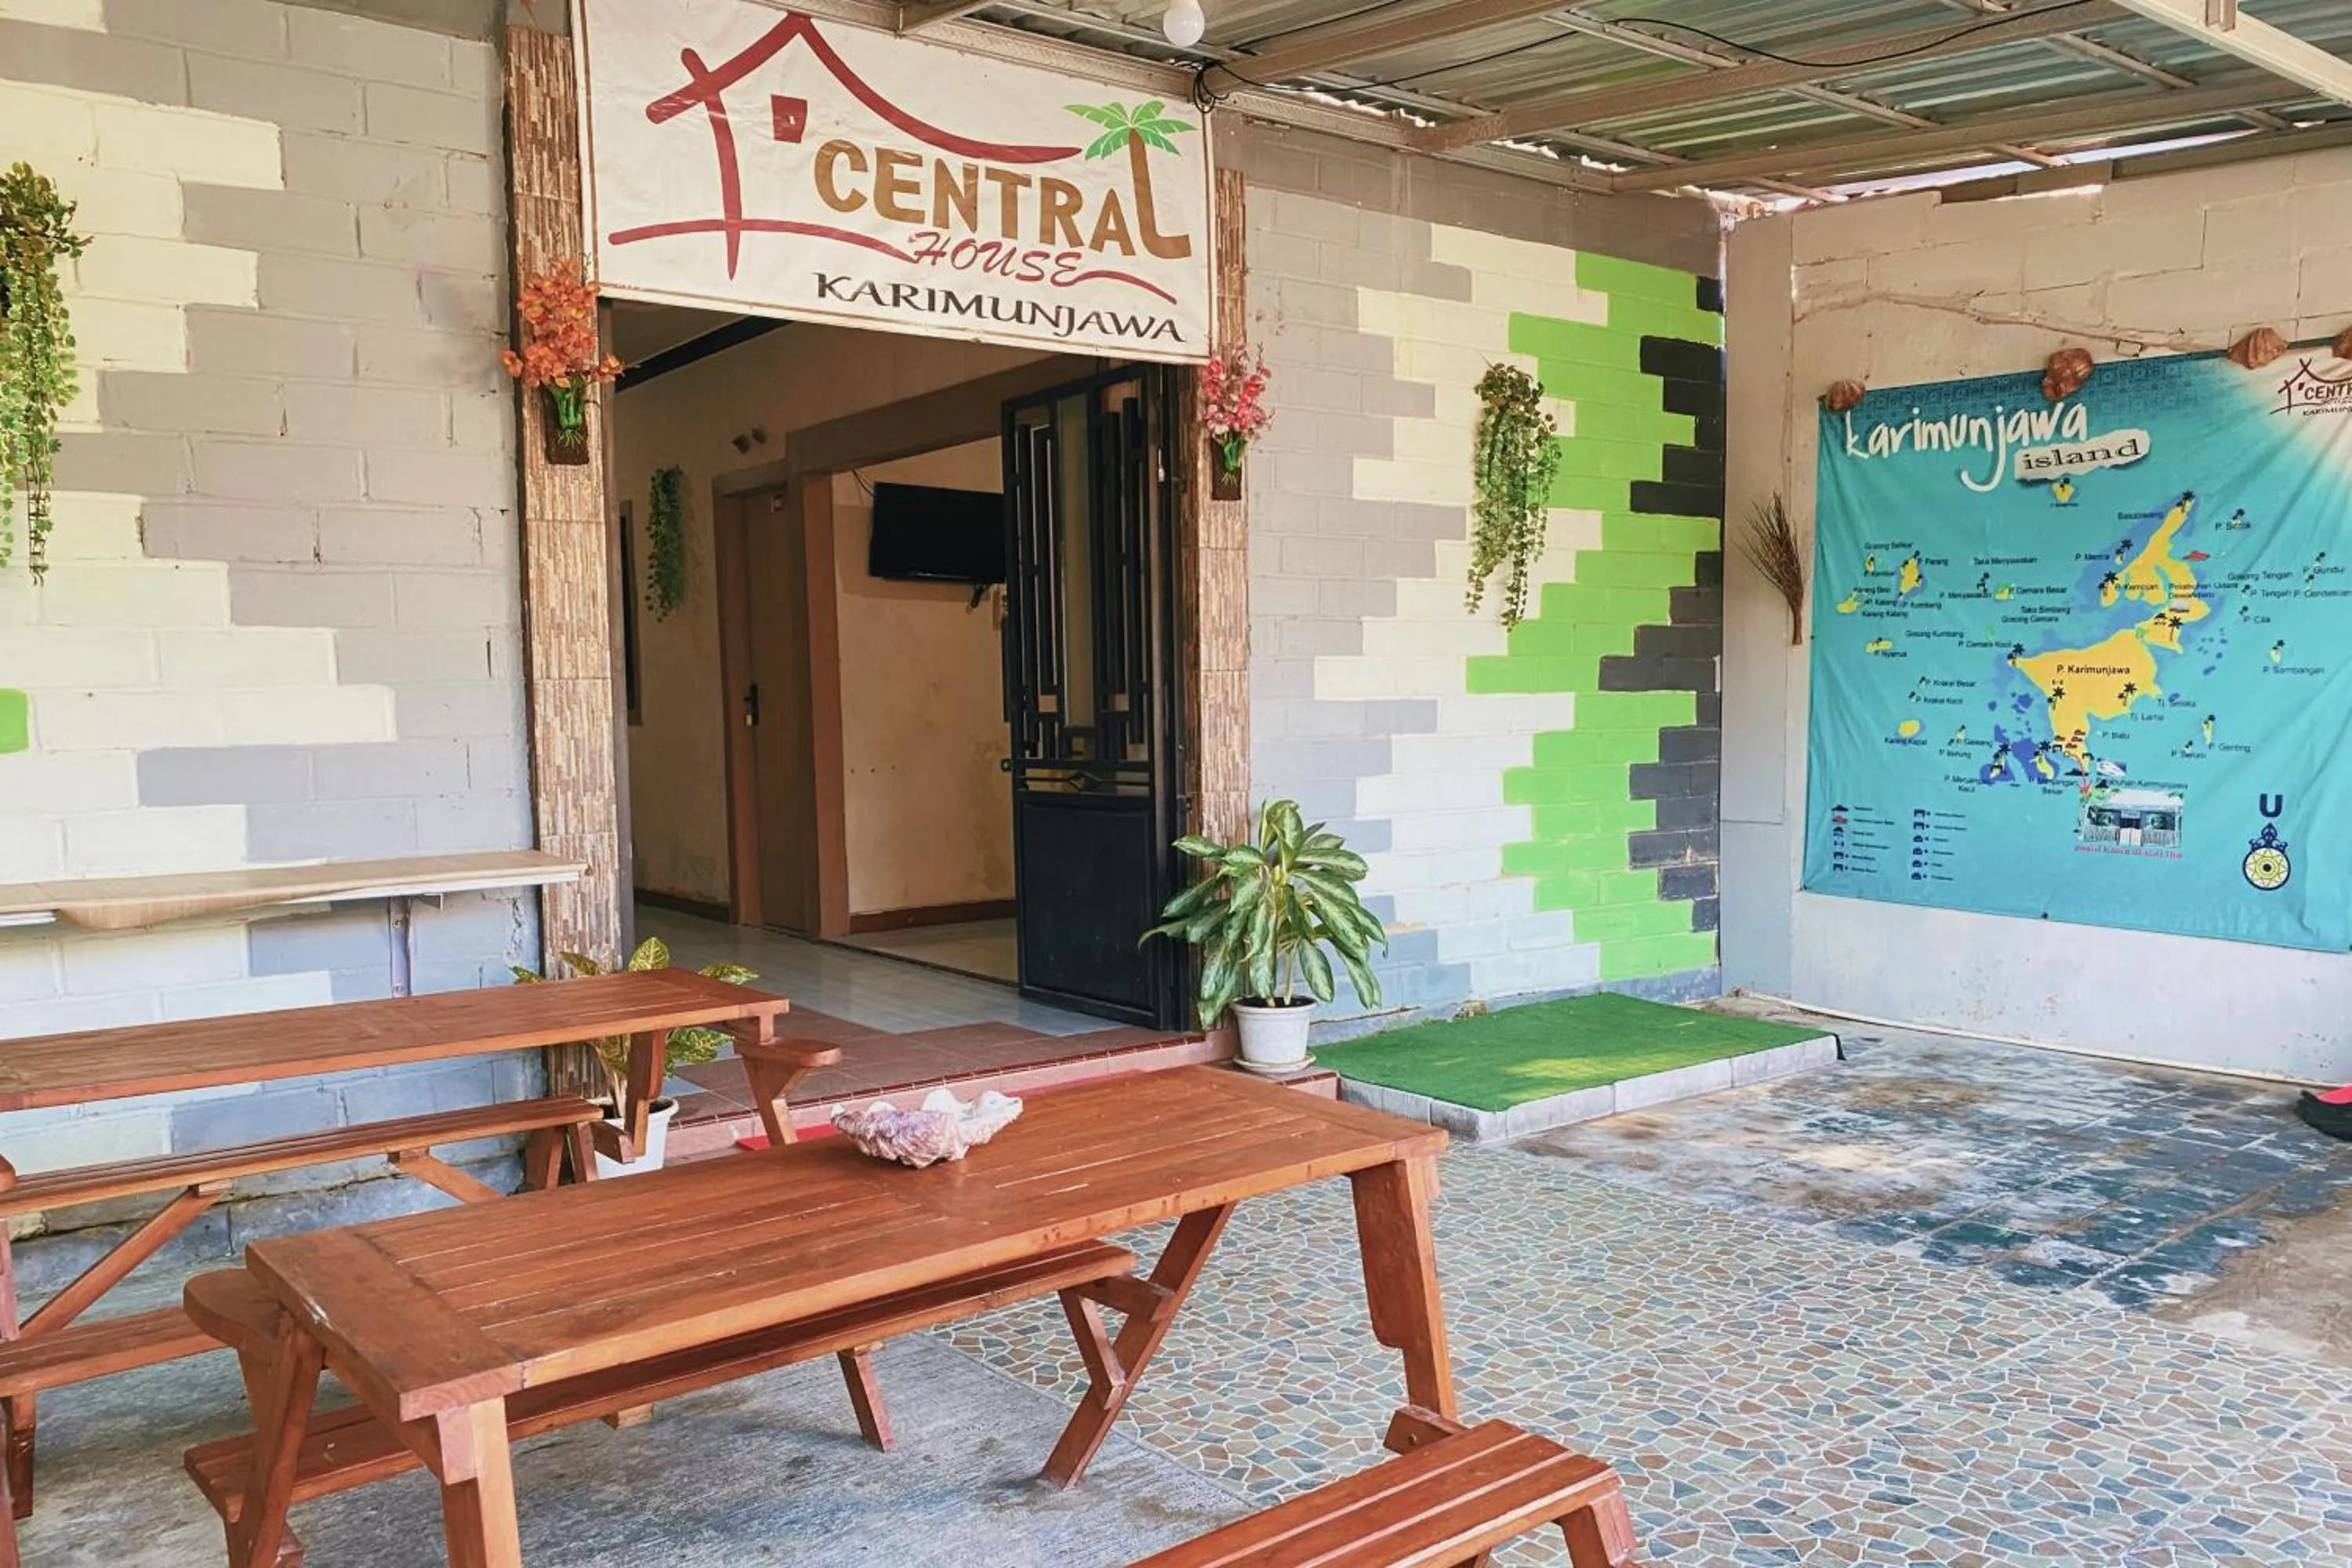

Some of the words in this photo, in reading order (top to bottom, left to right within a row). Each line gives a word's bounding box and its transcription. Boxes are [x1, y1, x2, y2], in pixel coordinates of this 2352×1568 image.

[814, 126, 1192, 259] CENTRAL
[908, 230, 1083, 288] HOUSE
[812, 271, 1187, 343] KARIMUNJAWA
[1845, 402, 2089, 492] karimunjawa
[2023, 438, 2143, 471] island
[2067, 665, 2131, 676] Karimunjawa
[2259, 793, 2283, 818] U
